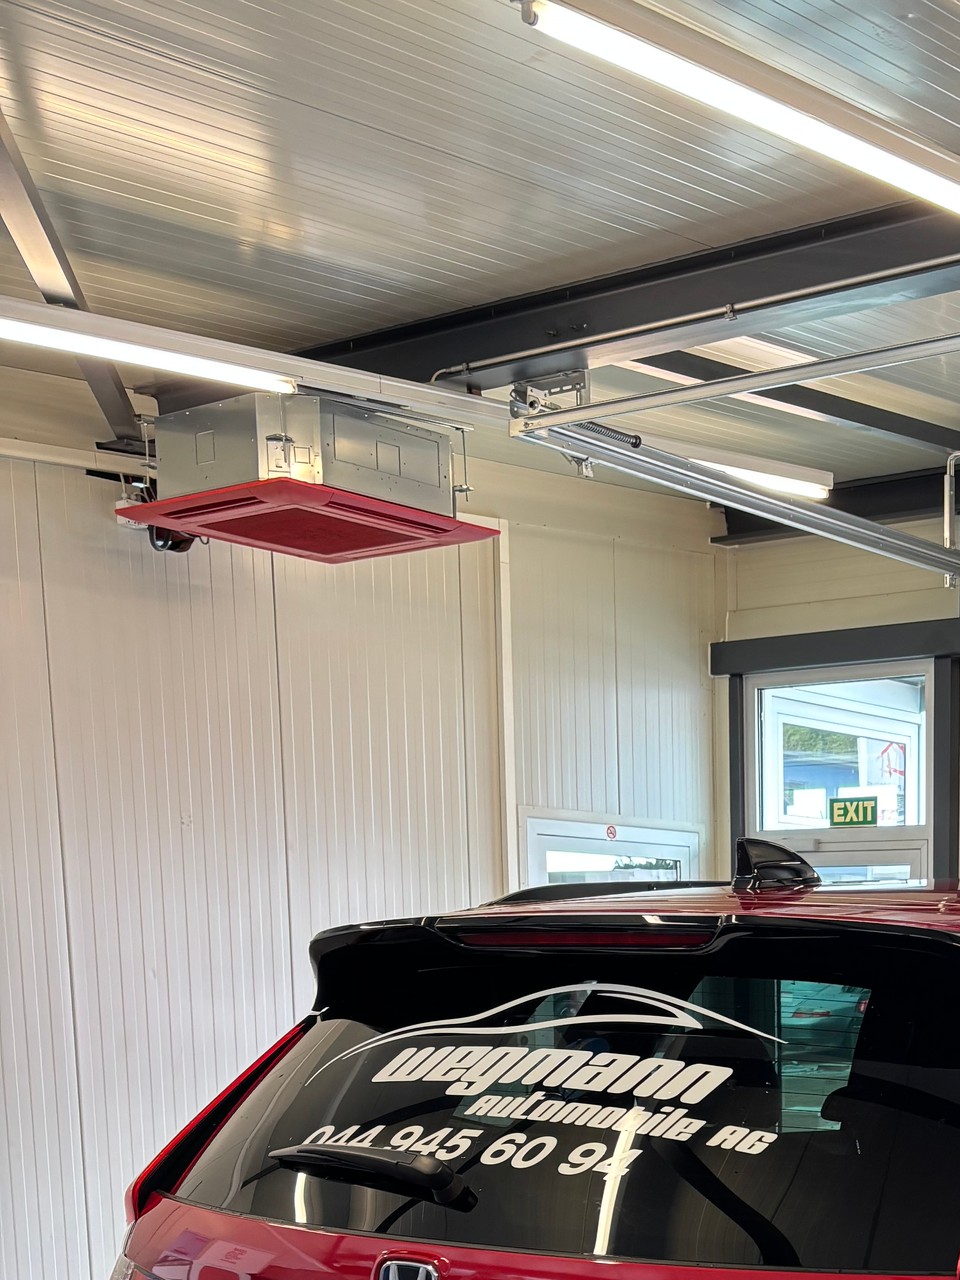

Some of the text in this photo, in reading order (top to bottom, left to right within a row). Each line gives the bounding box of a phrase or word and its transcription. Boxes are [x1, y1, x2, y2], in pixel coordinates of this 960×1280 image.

[832, 800, 876, 823] EXIT
[301, 1125, 644, 1181] 044 945 60 94
[706, 1125, 778, 1154] AG
